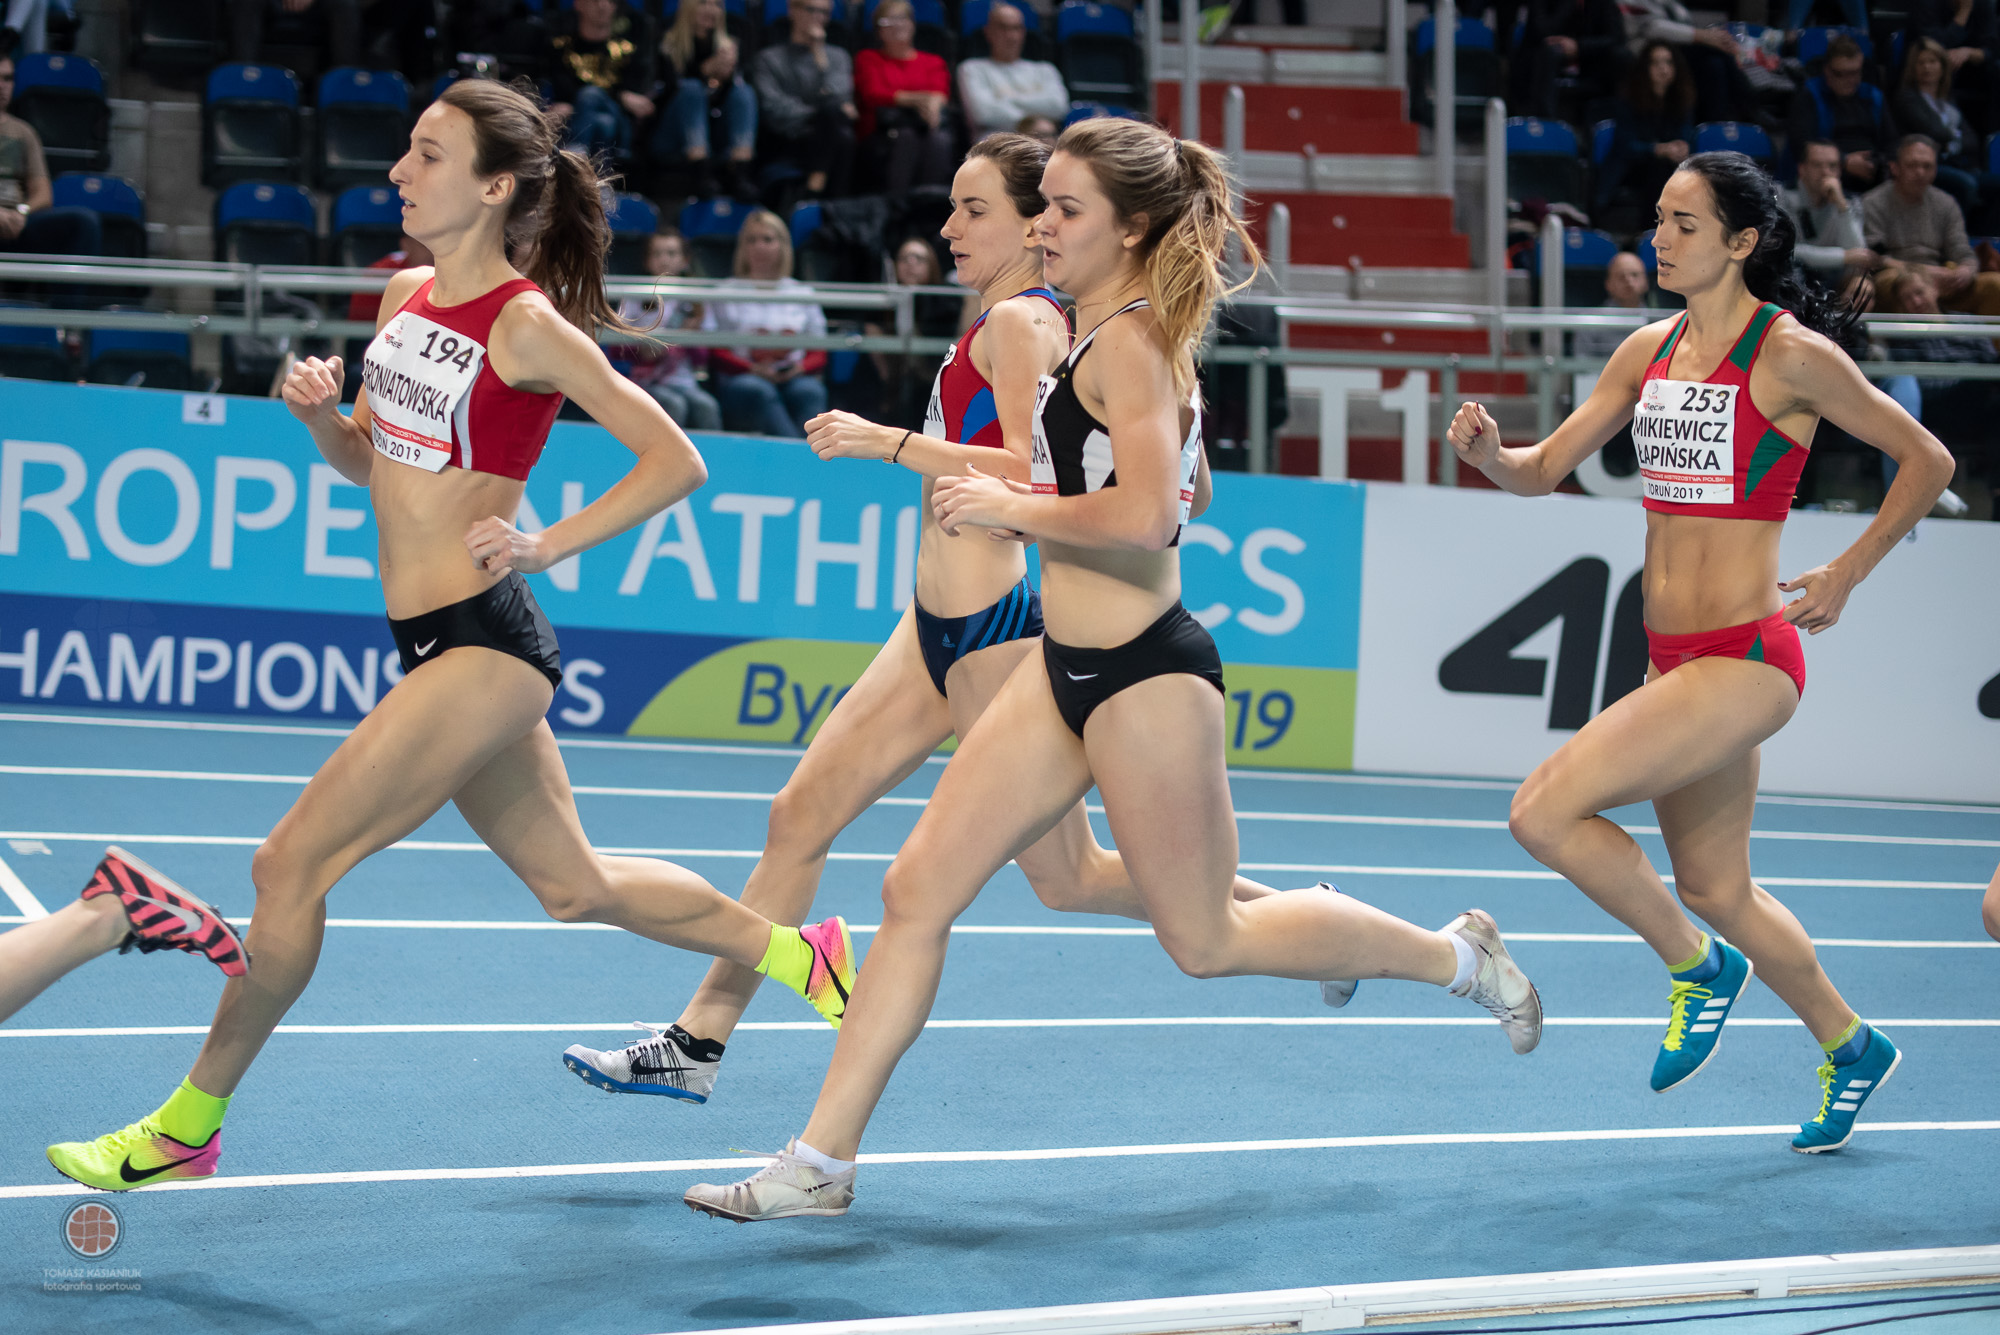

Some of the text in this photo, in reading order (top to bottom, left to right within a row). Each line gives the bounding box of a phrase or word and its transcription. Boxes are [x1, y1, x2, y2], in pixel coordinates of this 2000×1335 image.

[419, 330, 474, 374] 194
[1035, 380, 1048, 412] 79
[1680, 386, 1730, 414] 253
[1633, 415, 1728, 443] MIKIEWICZ
[389, 441, 421, 462] 2019
[1638, 442, 1721, 470] ŁAPIŃSKA
[1648, 482, 1703, 500] TORUŃ 2019
[0, 440, 585, 593] ROPEN
[1231, 689, 1295, 752] 19
